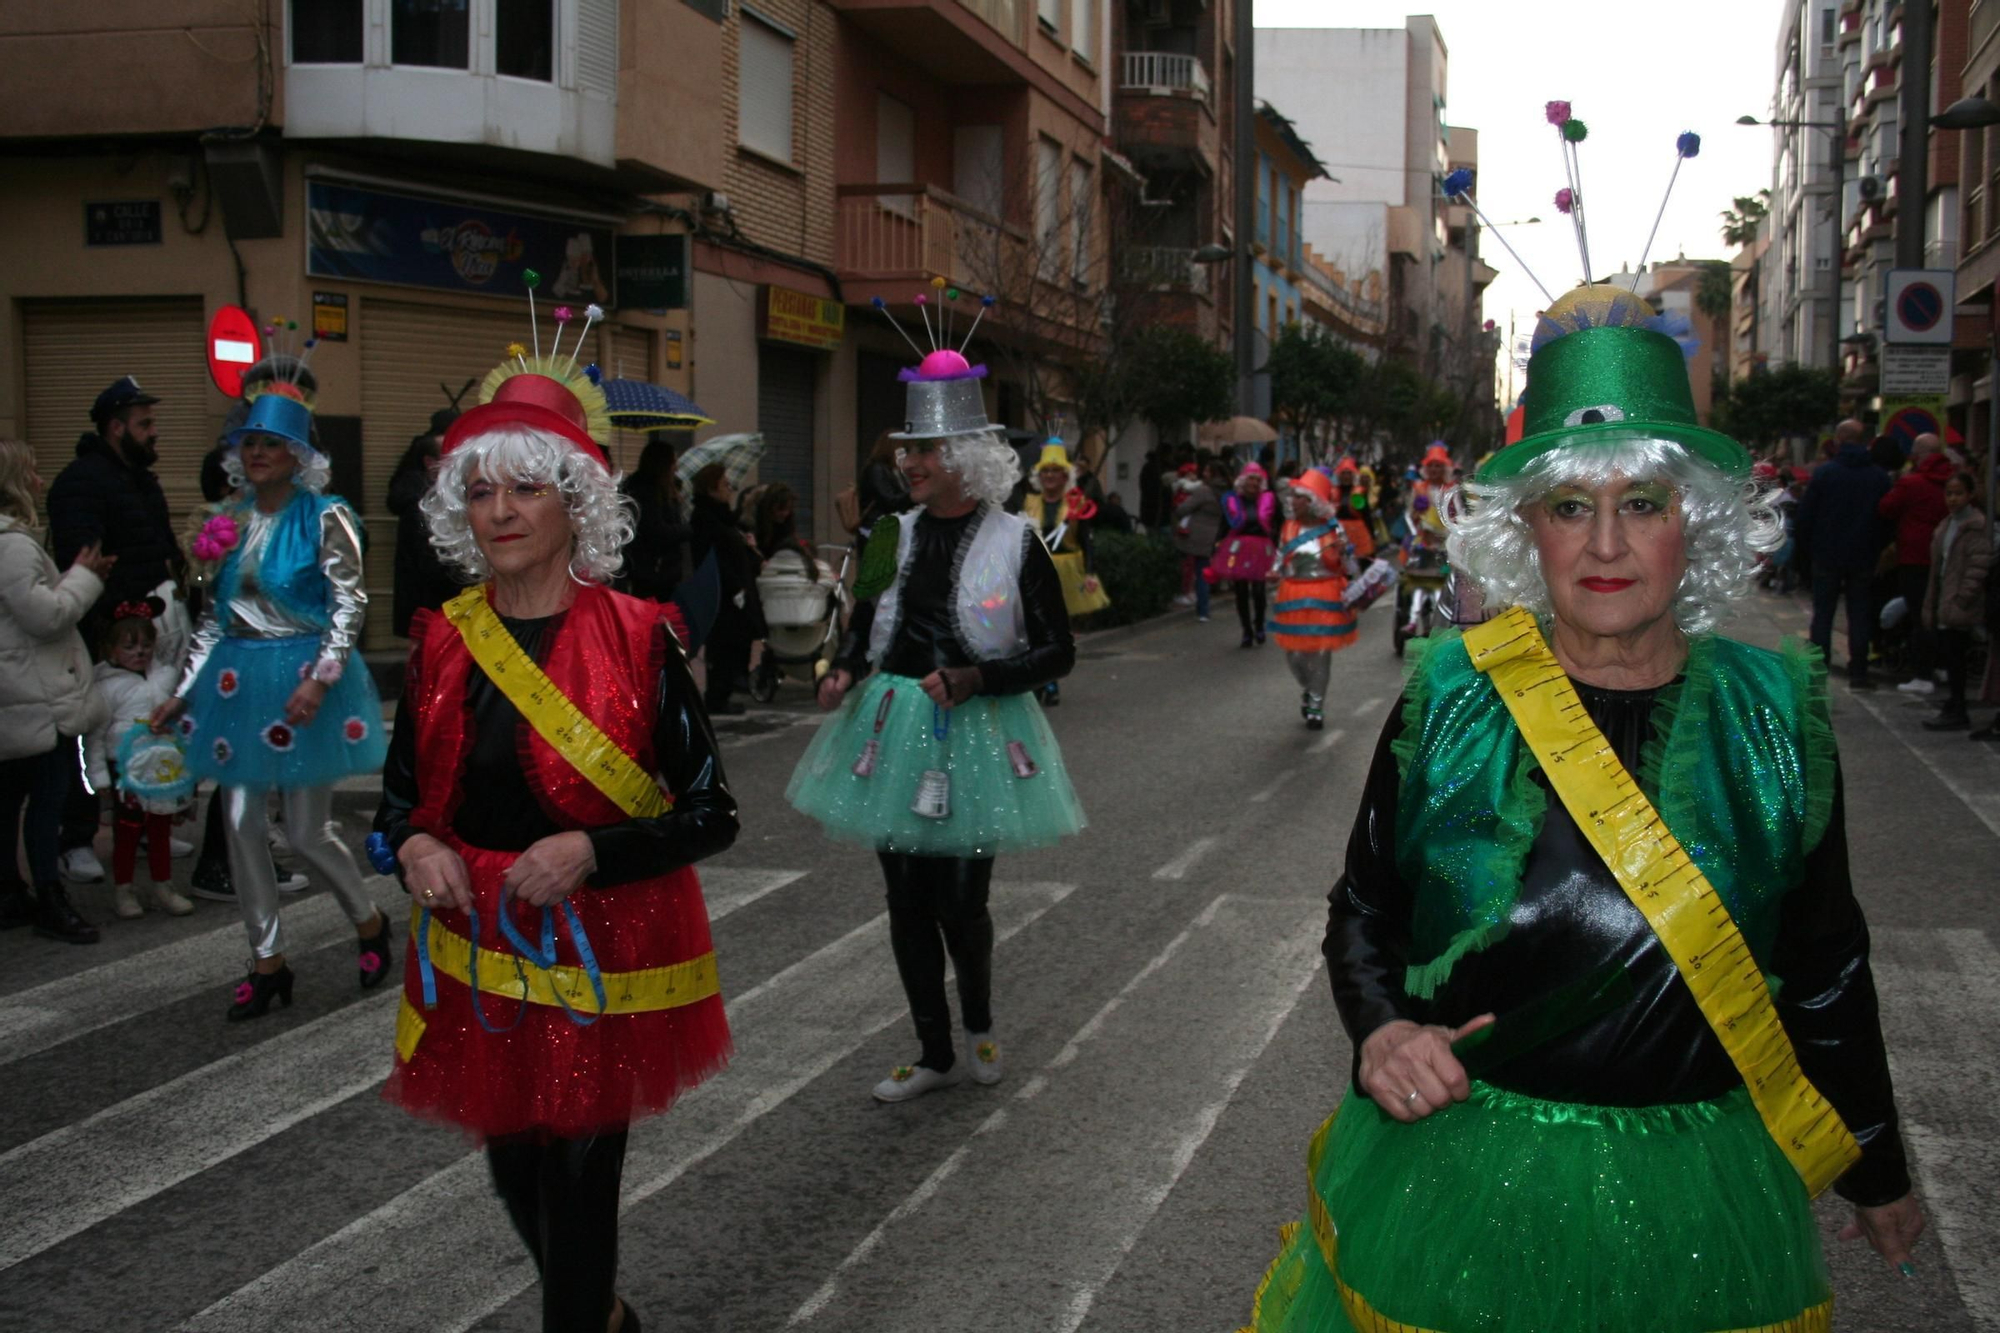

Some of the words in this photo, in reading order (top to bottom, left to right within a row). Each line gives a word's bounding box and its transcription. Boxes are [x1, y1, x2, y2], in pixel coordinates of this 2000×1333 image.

[113, 204, 149, 218] CALLE
[556, 728, 573, 744] 210
[1514, 689, 1525, 698] 10
[1550, 752, 1565, 764] 15
[1688, 955, 1702, 970] 30
[1723, 1018, 1736, 1031] 35
[1790, 1137, 1805, 1151] 45
[565, 988, 582, 998] 120
